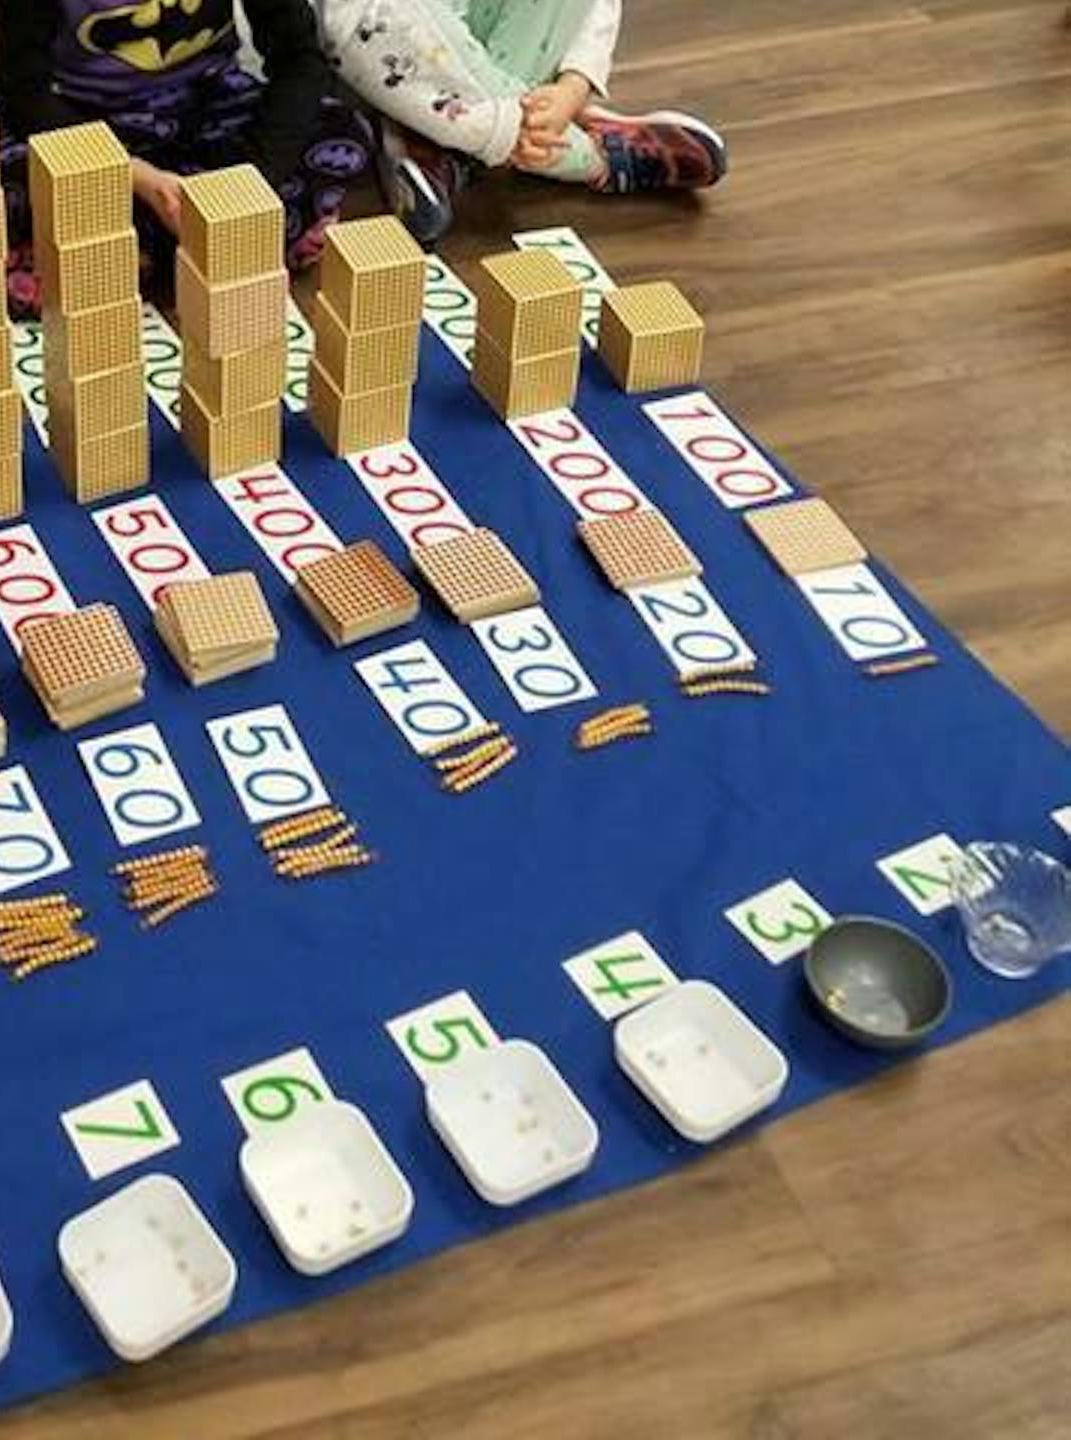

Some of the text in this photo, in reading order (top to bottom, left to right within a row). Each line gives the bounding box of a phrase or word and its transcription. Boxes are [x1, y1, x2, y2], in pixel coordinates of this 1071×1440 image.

[520, 420, 640, 515] 200
[658, 408, 777, 496] 100
[106, 509, 189, 605] 50
[640, 591, 740, 662] 20
[813, 581, 908, 648] 10
[380, 656, 471, 735] 40
[489, 624, 581, 698] 30
[93, 743, 184, 828] 60
[222, 725, 314, 806] 50
[747, 901, 823, 942] 3
[593, 953, 665, 1000] 4
[405, 1016, 489, 1064] 5
[75, 1100, 163, 1140] 7
[242, 1075, 324, 1122] 6
